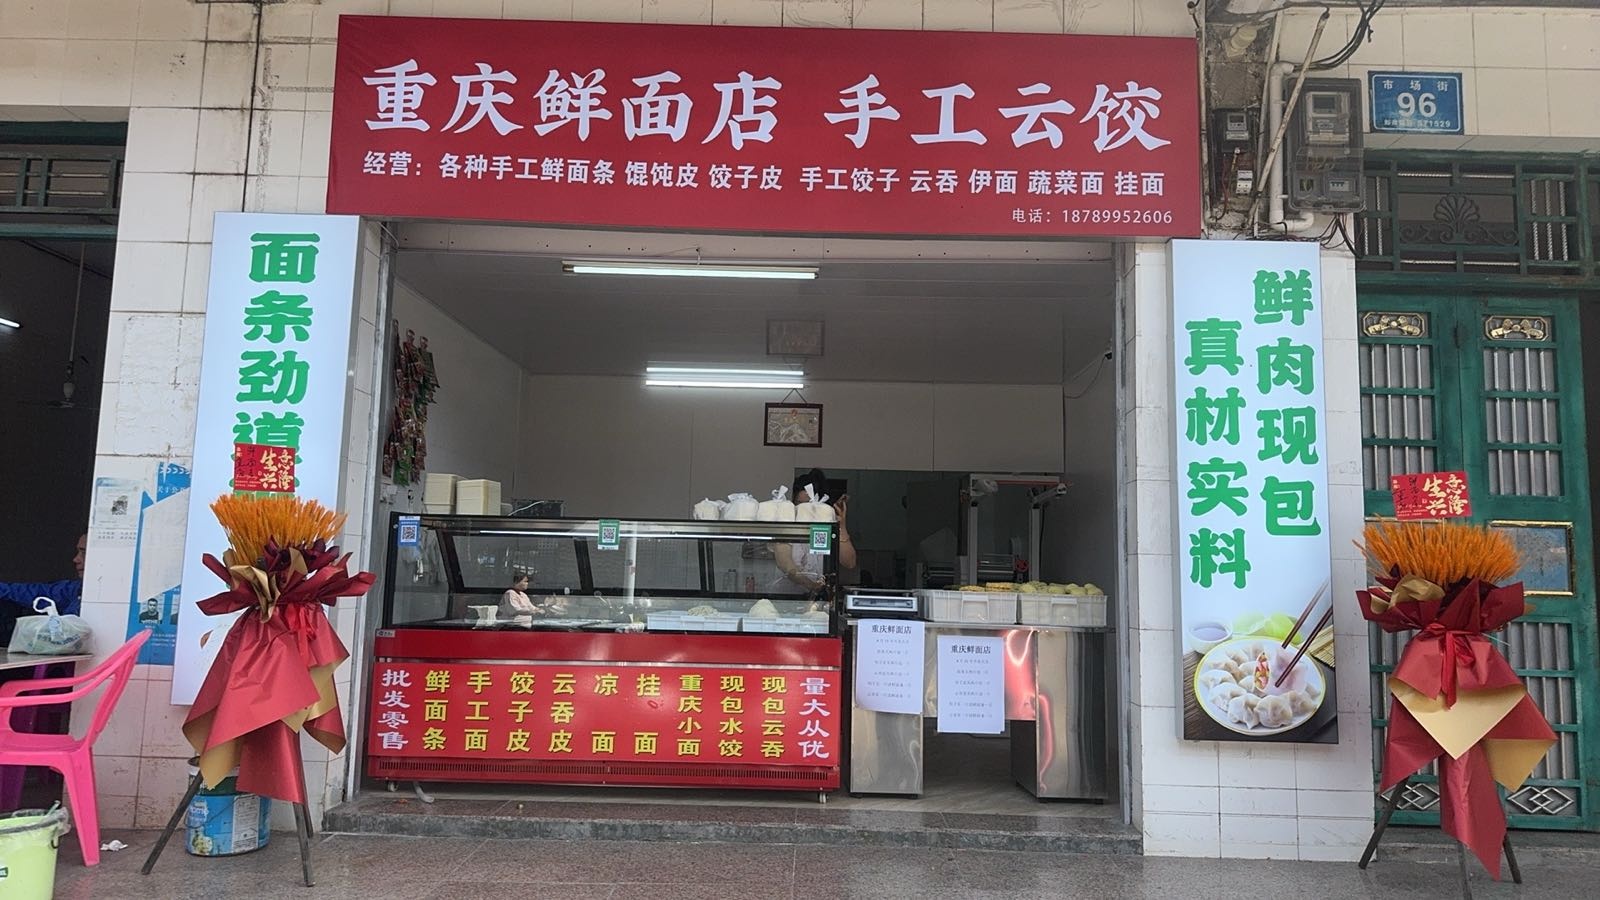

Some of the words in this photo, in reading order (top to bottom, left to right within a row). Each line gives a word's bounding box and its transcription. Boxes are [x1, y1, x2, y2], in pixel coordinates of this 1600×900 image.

[363, 59, 782, 150] 重庆鲜面店
[824, 74, 1171, 153] 手工云饺
[1382, 79, 1449, 92] 市场街
[1397, 92, 1437, 118] 96
[439, 153, 615, 184] 各种手工鲜面条
[625, 161, 698, 188] 馄饨皮
[709, 164, 782, 190] 饺子皮
[800, 167, 899, 192] 手工饺子
[910, 170, 958, 193] 云吞
[969, 169, 1018, 194] 伊面
[1028, 170, 1104, 195] 蔬菜面
[1114, 171, 1164, 196] 挂面
[1061, 208, 1173, 225] 18789952606
[231, 232, 320, 498] 面条劲道
[1253, 269, 1321, 536] 鲜肉现包
[1184, 317, 1251, 589] 真材实料
[871, 624, 912, 635] 重庆鲜面店
[950, 644, 991, 655] 重庆鲜面店
[378, 670, 411, 749] 批发零售
[423, 671, 449, 749] 鲜面条
[465, 671, 492, 750] 手工面
[508, 672, 533, 751] 饺子皮
[549, 674, 574, 752] 云吞皮
[678, 675, 702, 755] 重庆小面
[719, 676, 745, 756] 现包水饺
[761, 677, 787, 757] 现包云吞
[798, 678, 830, 758] 量大从优
